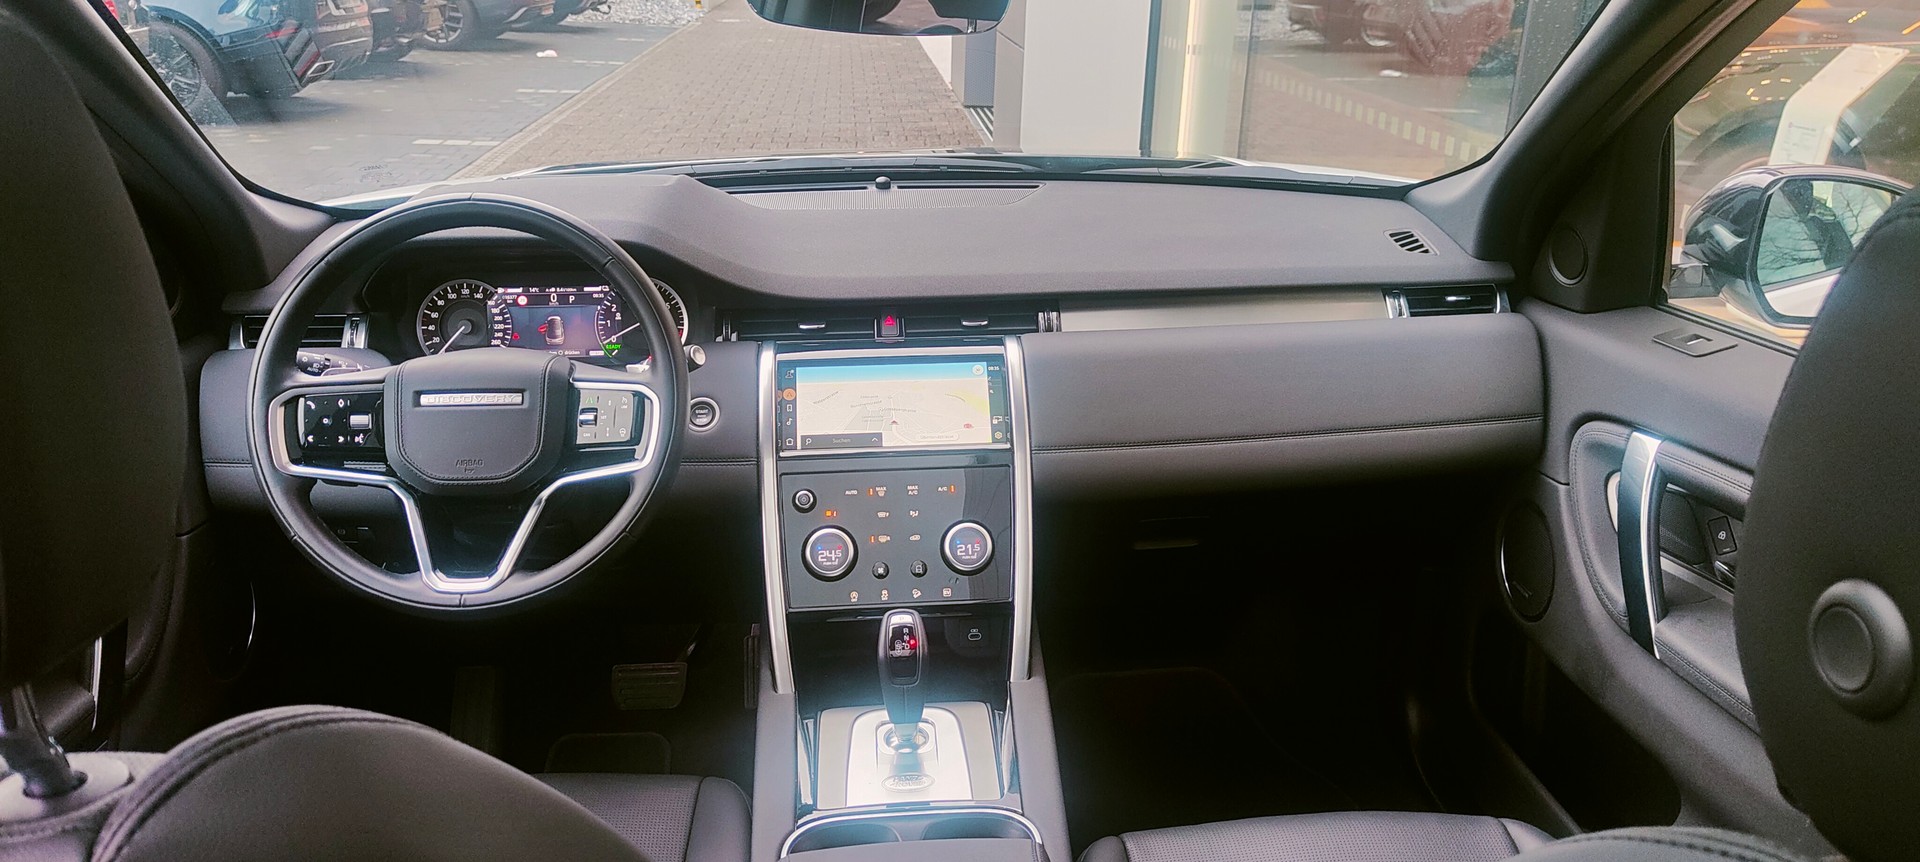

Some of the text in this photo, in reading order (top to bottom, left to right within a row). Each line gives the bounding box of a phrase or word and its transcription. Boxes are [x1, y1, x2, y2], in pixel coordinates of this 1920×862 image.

[550, 293, 557, 302] 0
[569, 295, 575, 303] P
[957, 544, 980, 555] 21.5
[818, 550, 842, 561] 24.5
